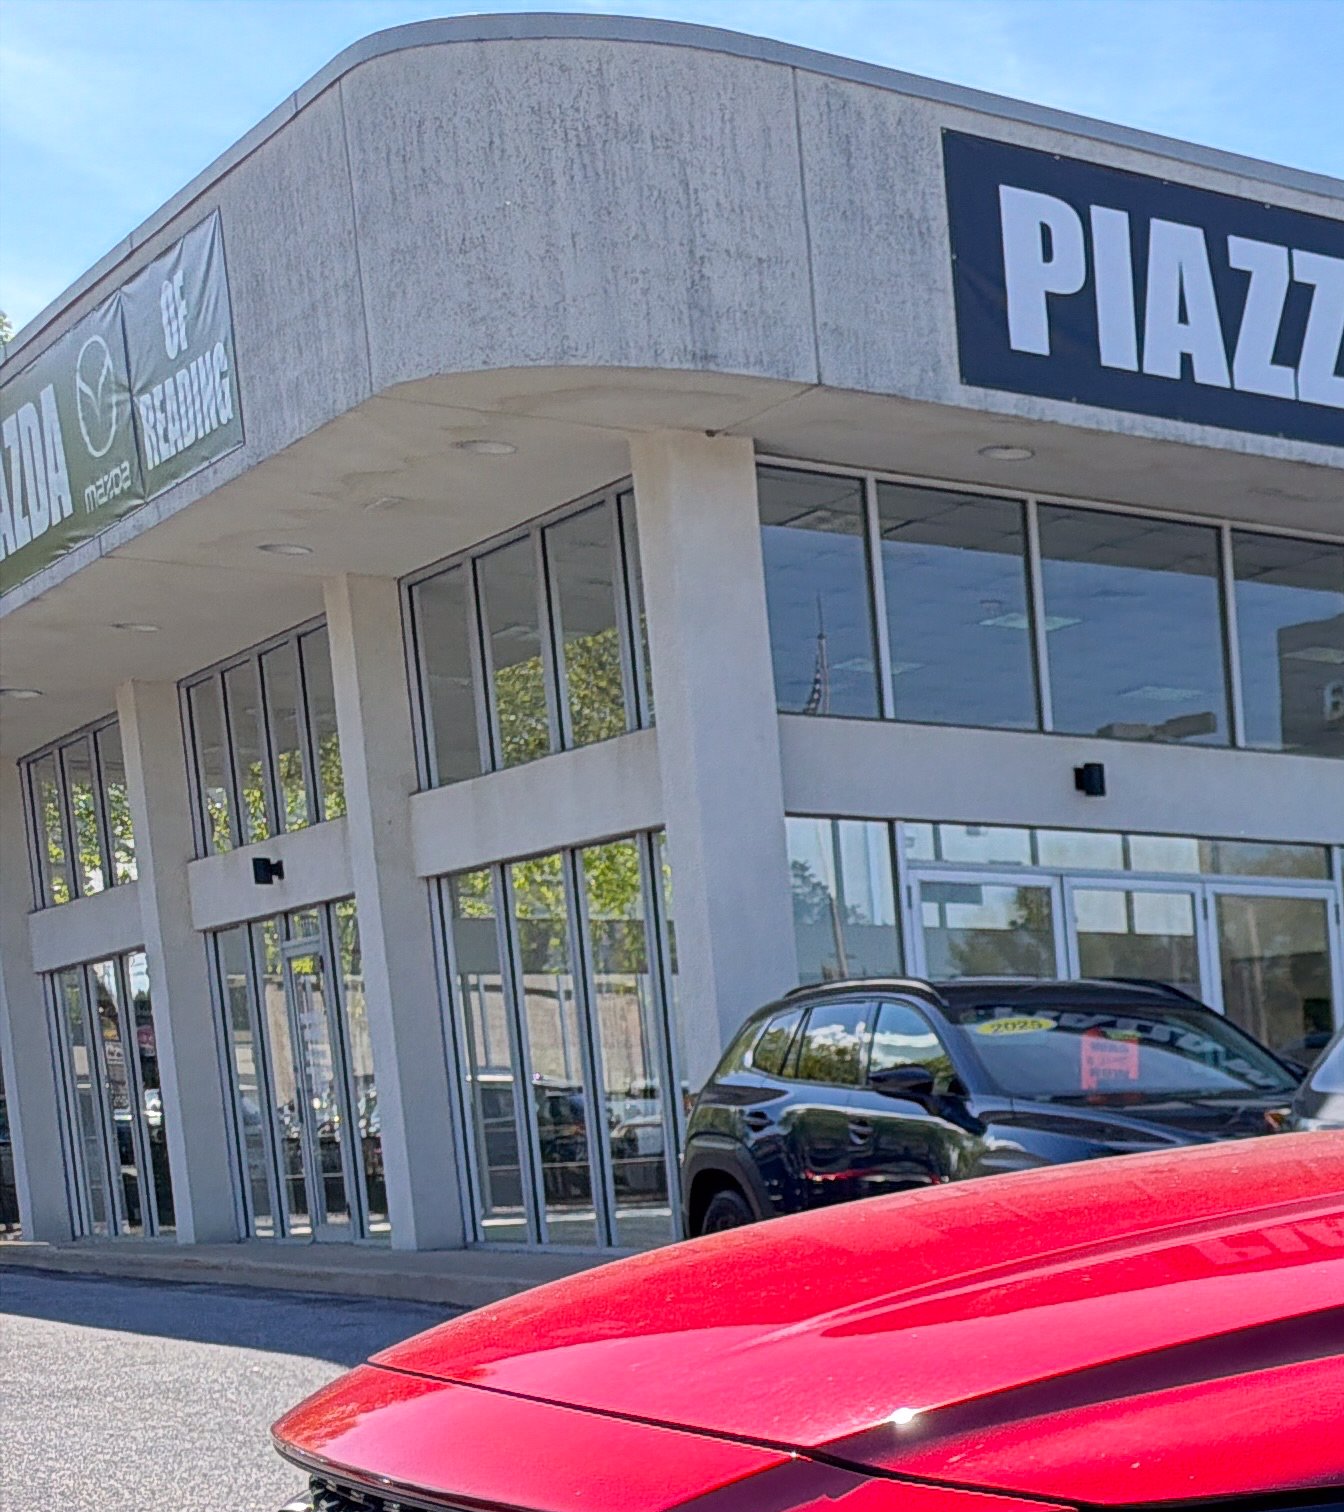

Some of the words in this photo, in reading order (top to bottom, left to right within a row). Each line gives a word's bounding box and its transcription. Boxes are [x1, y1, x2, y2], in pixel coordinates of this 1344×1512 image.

[161, 270, 189, 360] OF
[139, 342, 234, 470] READING
[84, 460, 131, 514] mazda
[991, 1020, 1043, 1033] 2025
